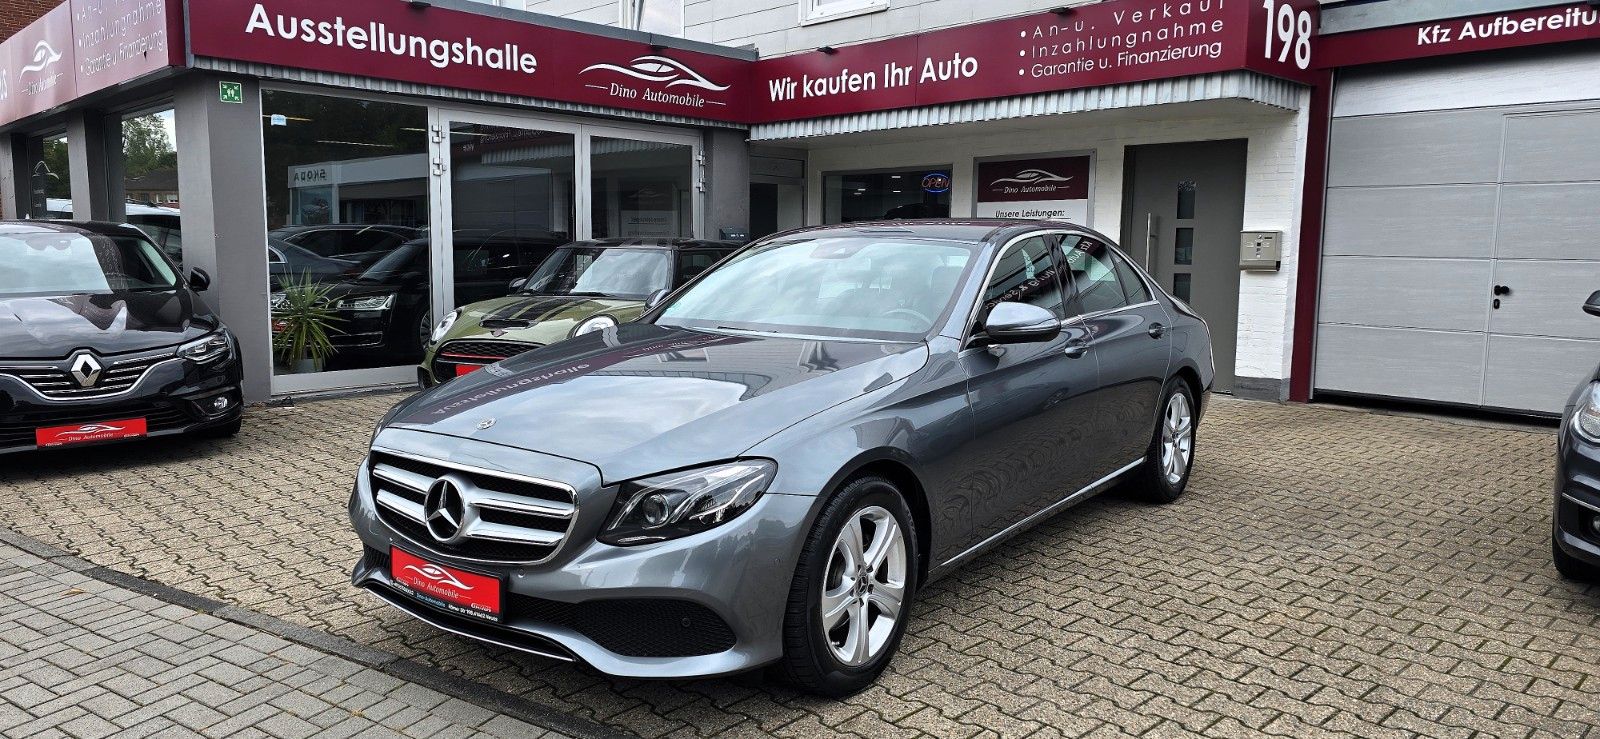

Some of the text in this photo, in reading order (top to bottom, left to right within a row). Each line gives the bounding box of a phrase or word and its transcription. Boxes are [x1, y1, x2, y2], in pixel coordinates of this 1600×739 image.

[245, 4, 537, 74] Ausstellungshalle
[1032, 19, 1224, 58] Inzahlungnahme
[1263, 0, 1311, 69] 198
[1417, 6, 1600, 46] Kfz Aufbereitu
[769, 52, 978, 102] Wir kaufen Ihr Auto
[1031, 40, 1222, 79] Garantie u. Finanzierung
[610, 82, 705, 108] Dino Automobile
[922, 177, 949, 188] OPEN
[1004, 184, 1057, 194] Dino Automobile
[995, 209, 1065, 219] Unsere Leistungen:
[413, 577, 425, 587] Dino
[427, 582, 459, 599] Automobile
